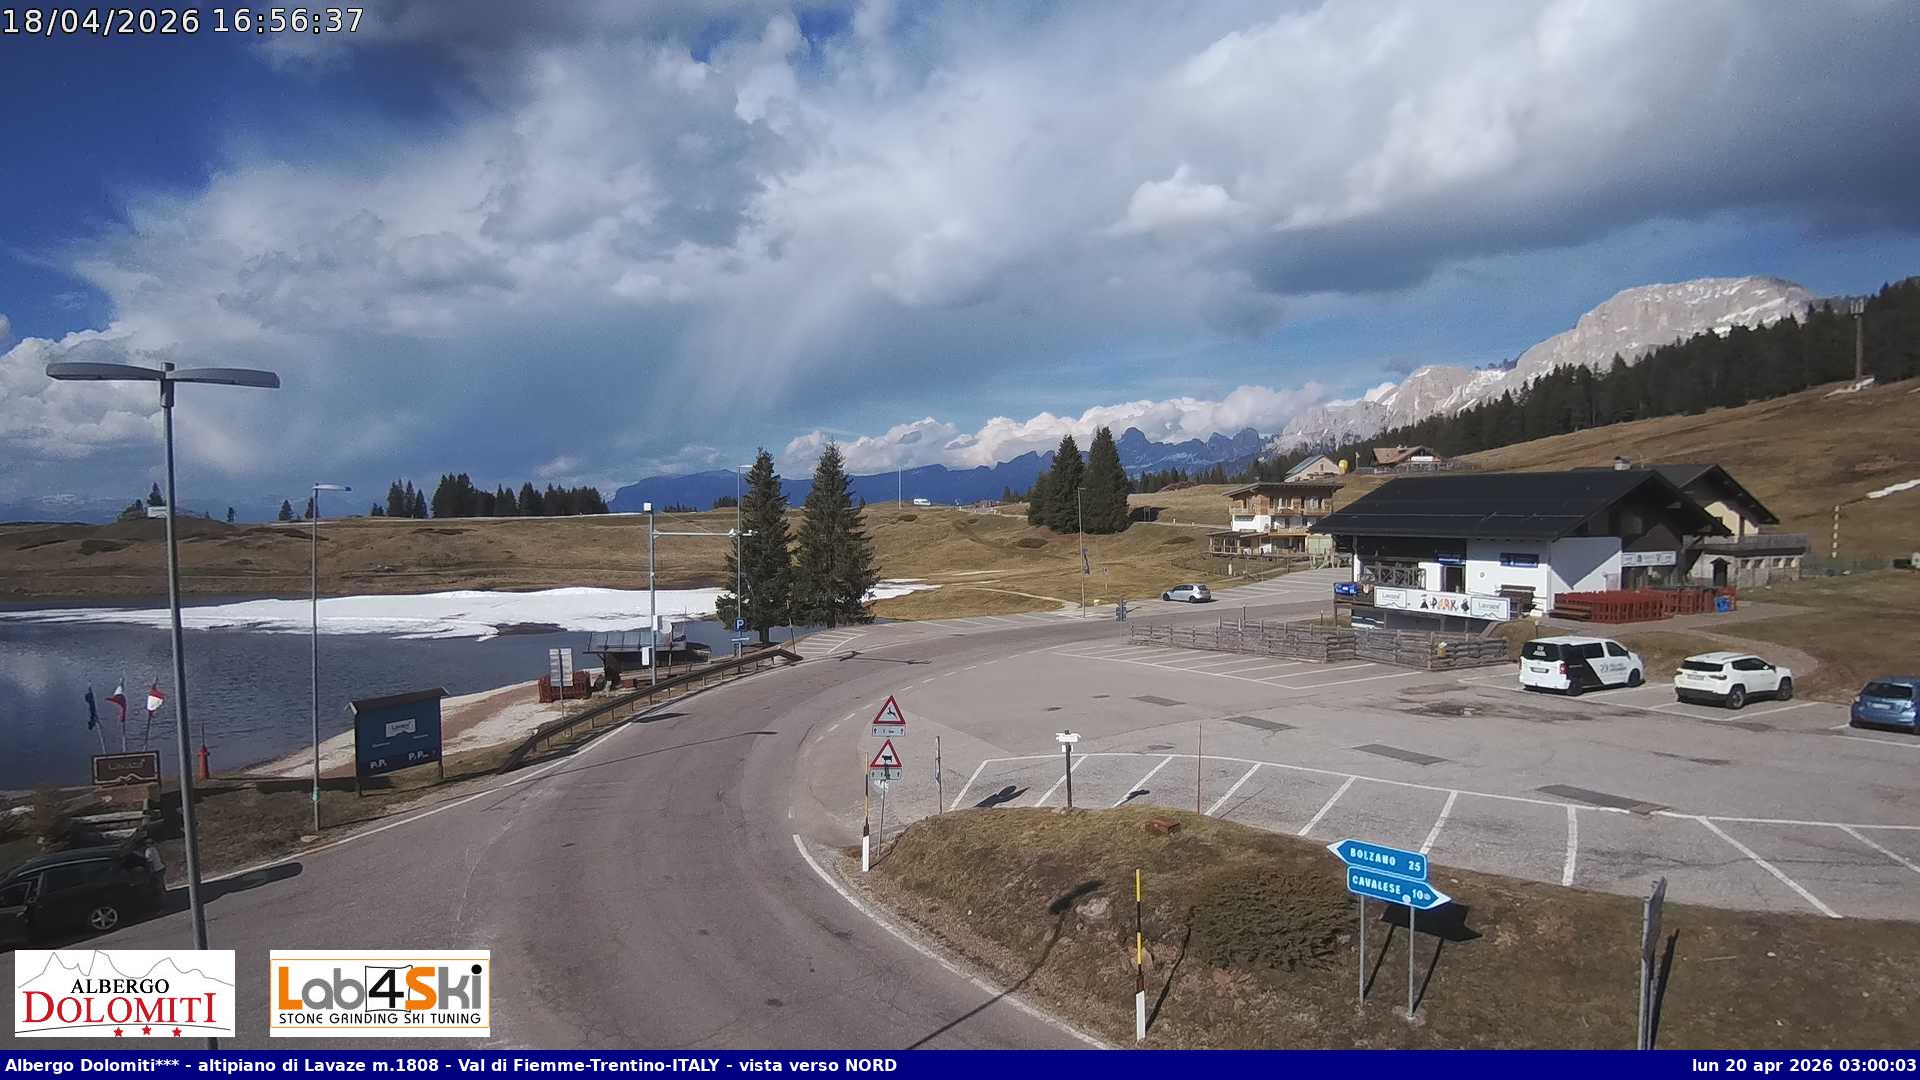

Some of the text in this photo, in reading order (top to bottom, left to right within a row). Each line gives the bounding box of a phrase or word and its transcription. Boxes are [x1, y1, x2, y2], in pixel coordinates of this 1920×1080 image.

[736, 619, 744, 629] P
[1350, 848, 1421, 872] BOLZANO 25
[1352, 875, 1401, 895] CAVALESE
